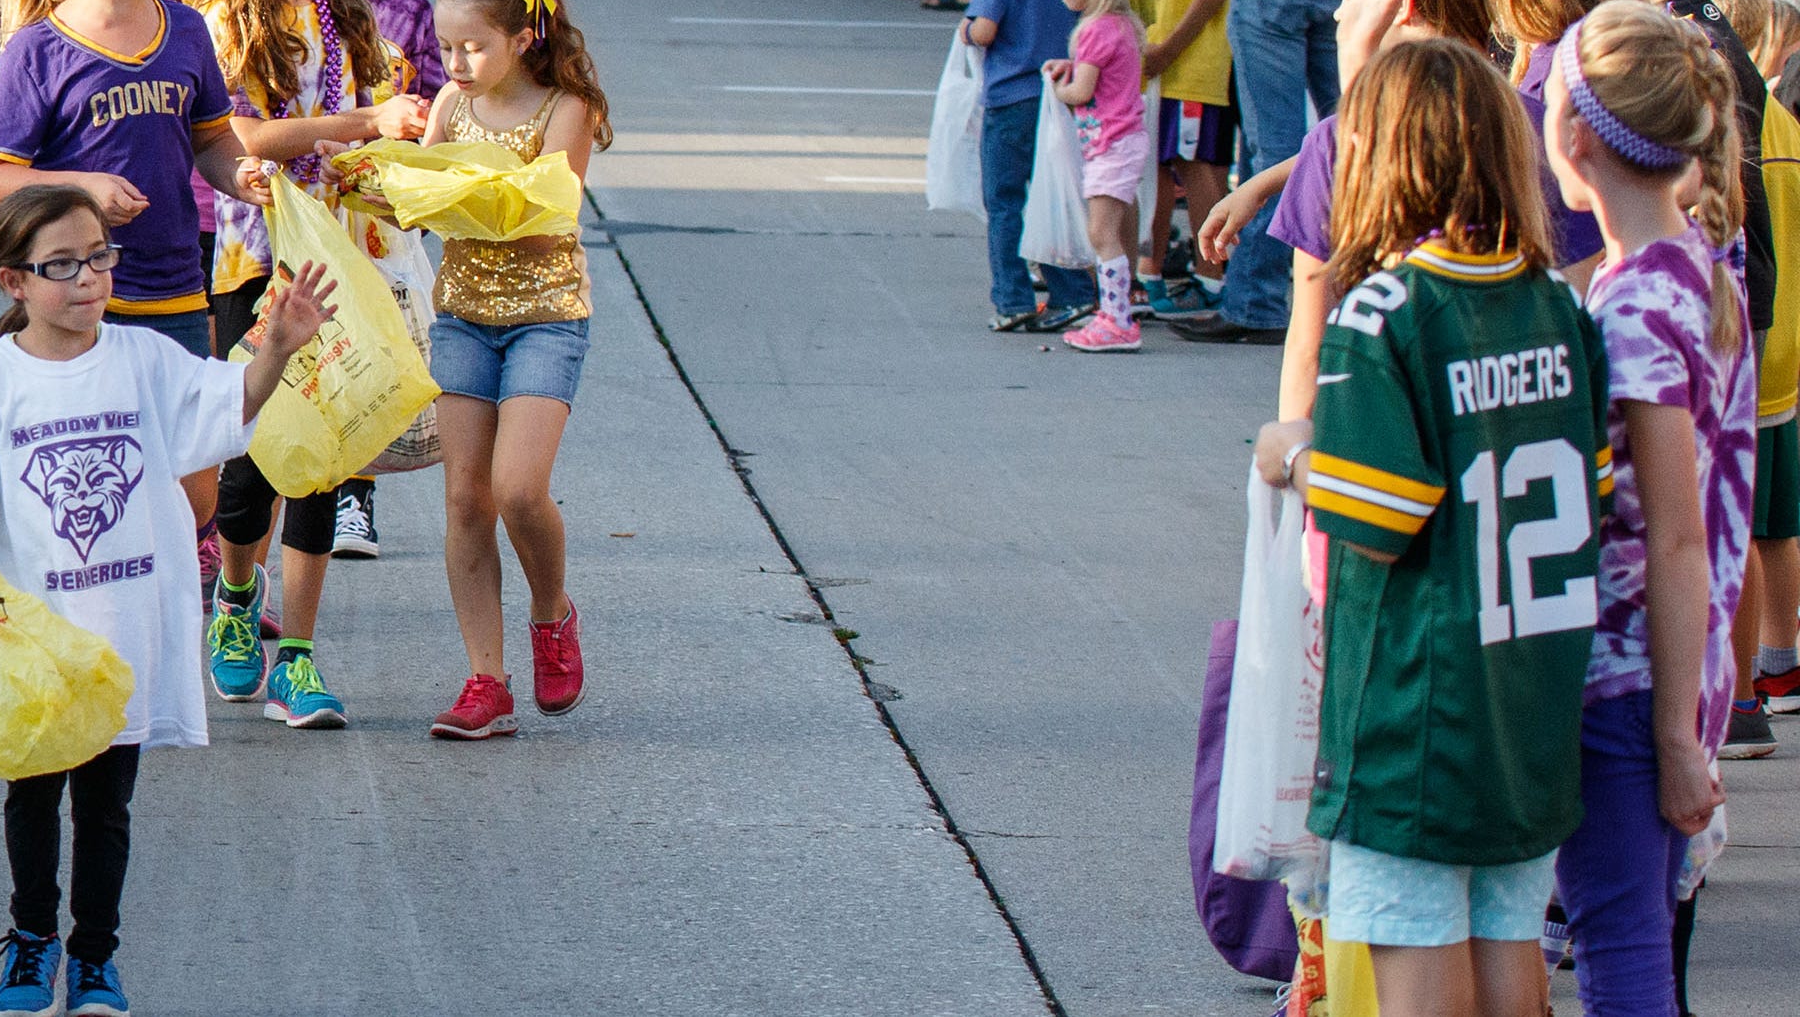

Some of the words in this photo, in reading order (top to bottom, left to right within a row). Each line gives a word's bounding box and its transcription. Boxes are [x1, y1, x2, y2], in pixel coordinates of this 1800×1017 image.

[90, 80, 190, 127] COONEY
[1447, 344, 1573, 417] RDGERS
[10, 416, 100, 449] MEADOW
[1460, 438, 1599, 646] 12
